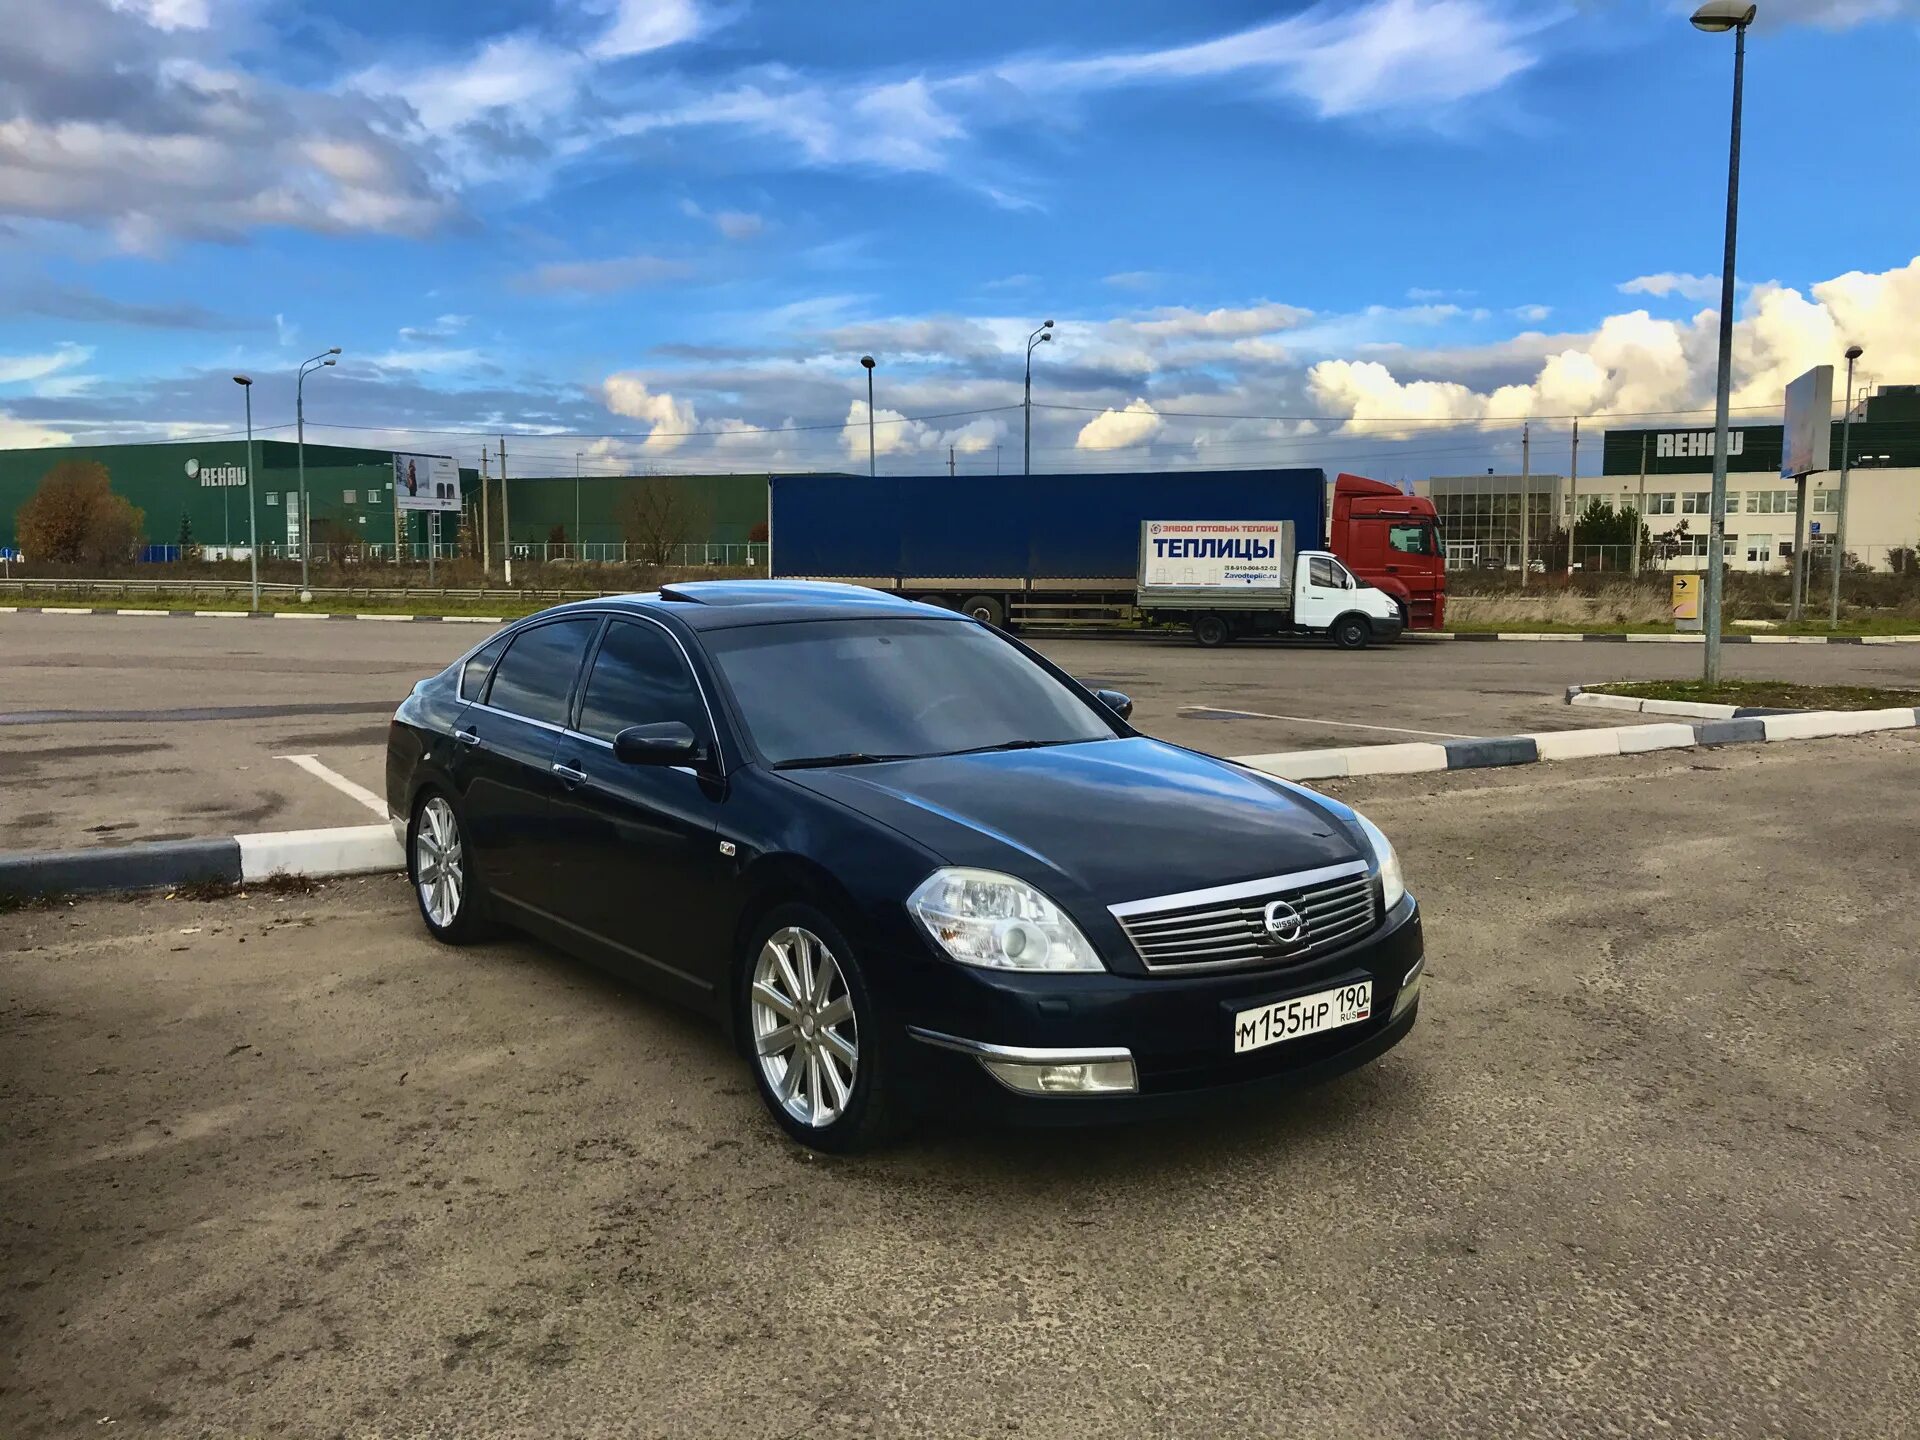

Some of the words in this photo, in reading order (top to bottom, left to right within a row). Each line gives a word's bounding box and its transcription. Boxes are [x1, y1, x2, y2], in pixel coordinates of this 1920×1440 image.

[200, 466, 247, 487] REHAU
[1162, 525, 1194, 533] ЗАВОД
[1195, 525, 1240, 533] ГОТОВЫХ
[1241, 525, 1279, 533] ТЕПЛИЦ
[1152, 538, 1275, 561] ТЕПЛИЦЫ
[1271, 917, 1301, 929] NISSAN
[1335, 984, 1367, 1012] 190
[1340, 1010, 1357, 1022] RUS
